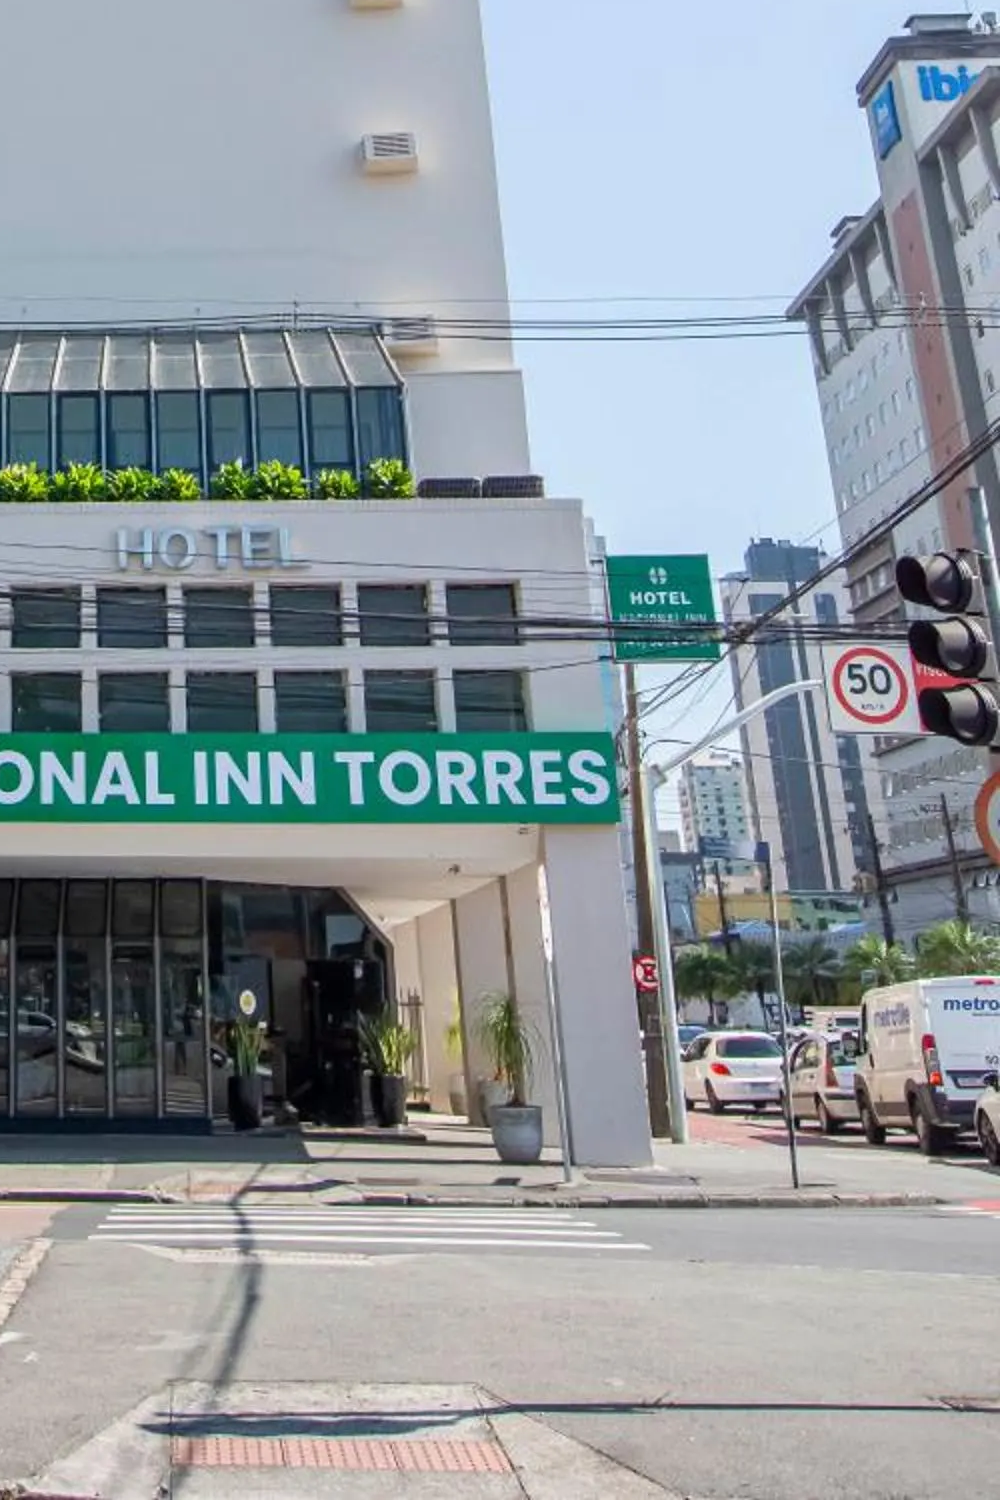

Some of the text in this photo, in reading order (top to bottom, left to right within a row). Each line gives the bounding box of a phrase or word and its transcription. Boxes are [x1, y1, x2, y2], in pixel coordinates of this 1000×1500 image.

[917, 64, 980, 102] ibi
[116, 524, 311, 571] HOTEL
[630, 591, 693, 605] HOTEL
[847, 663, 891, 695] 50
[193, 750, 317, 805] INN
[334, 749, 611, 805] TORRES
